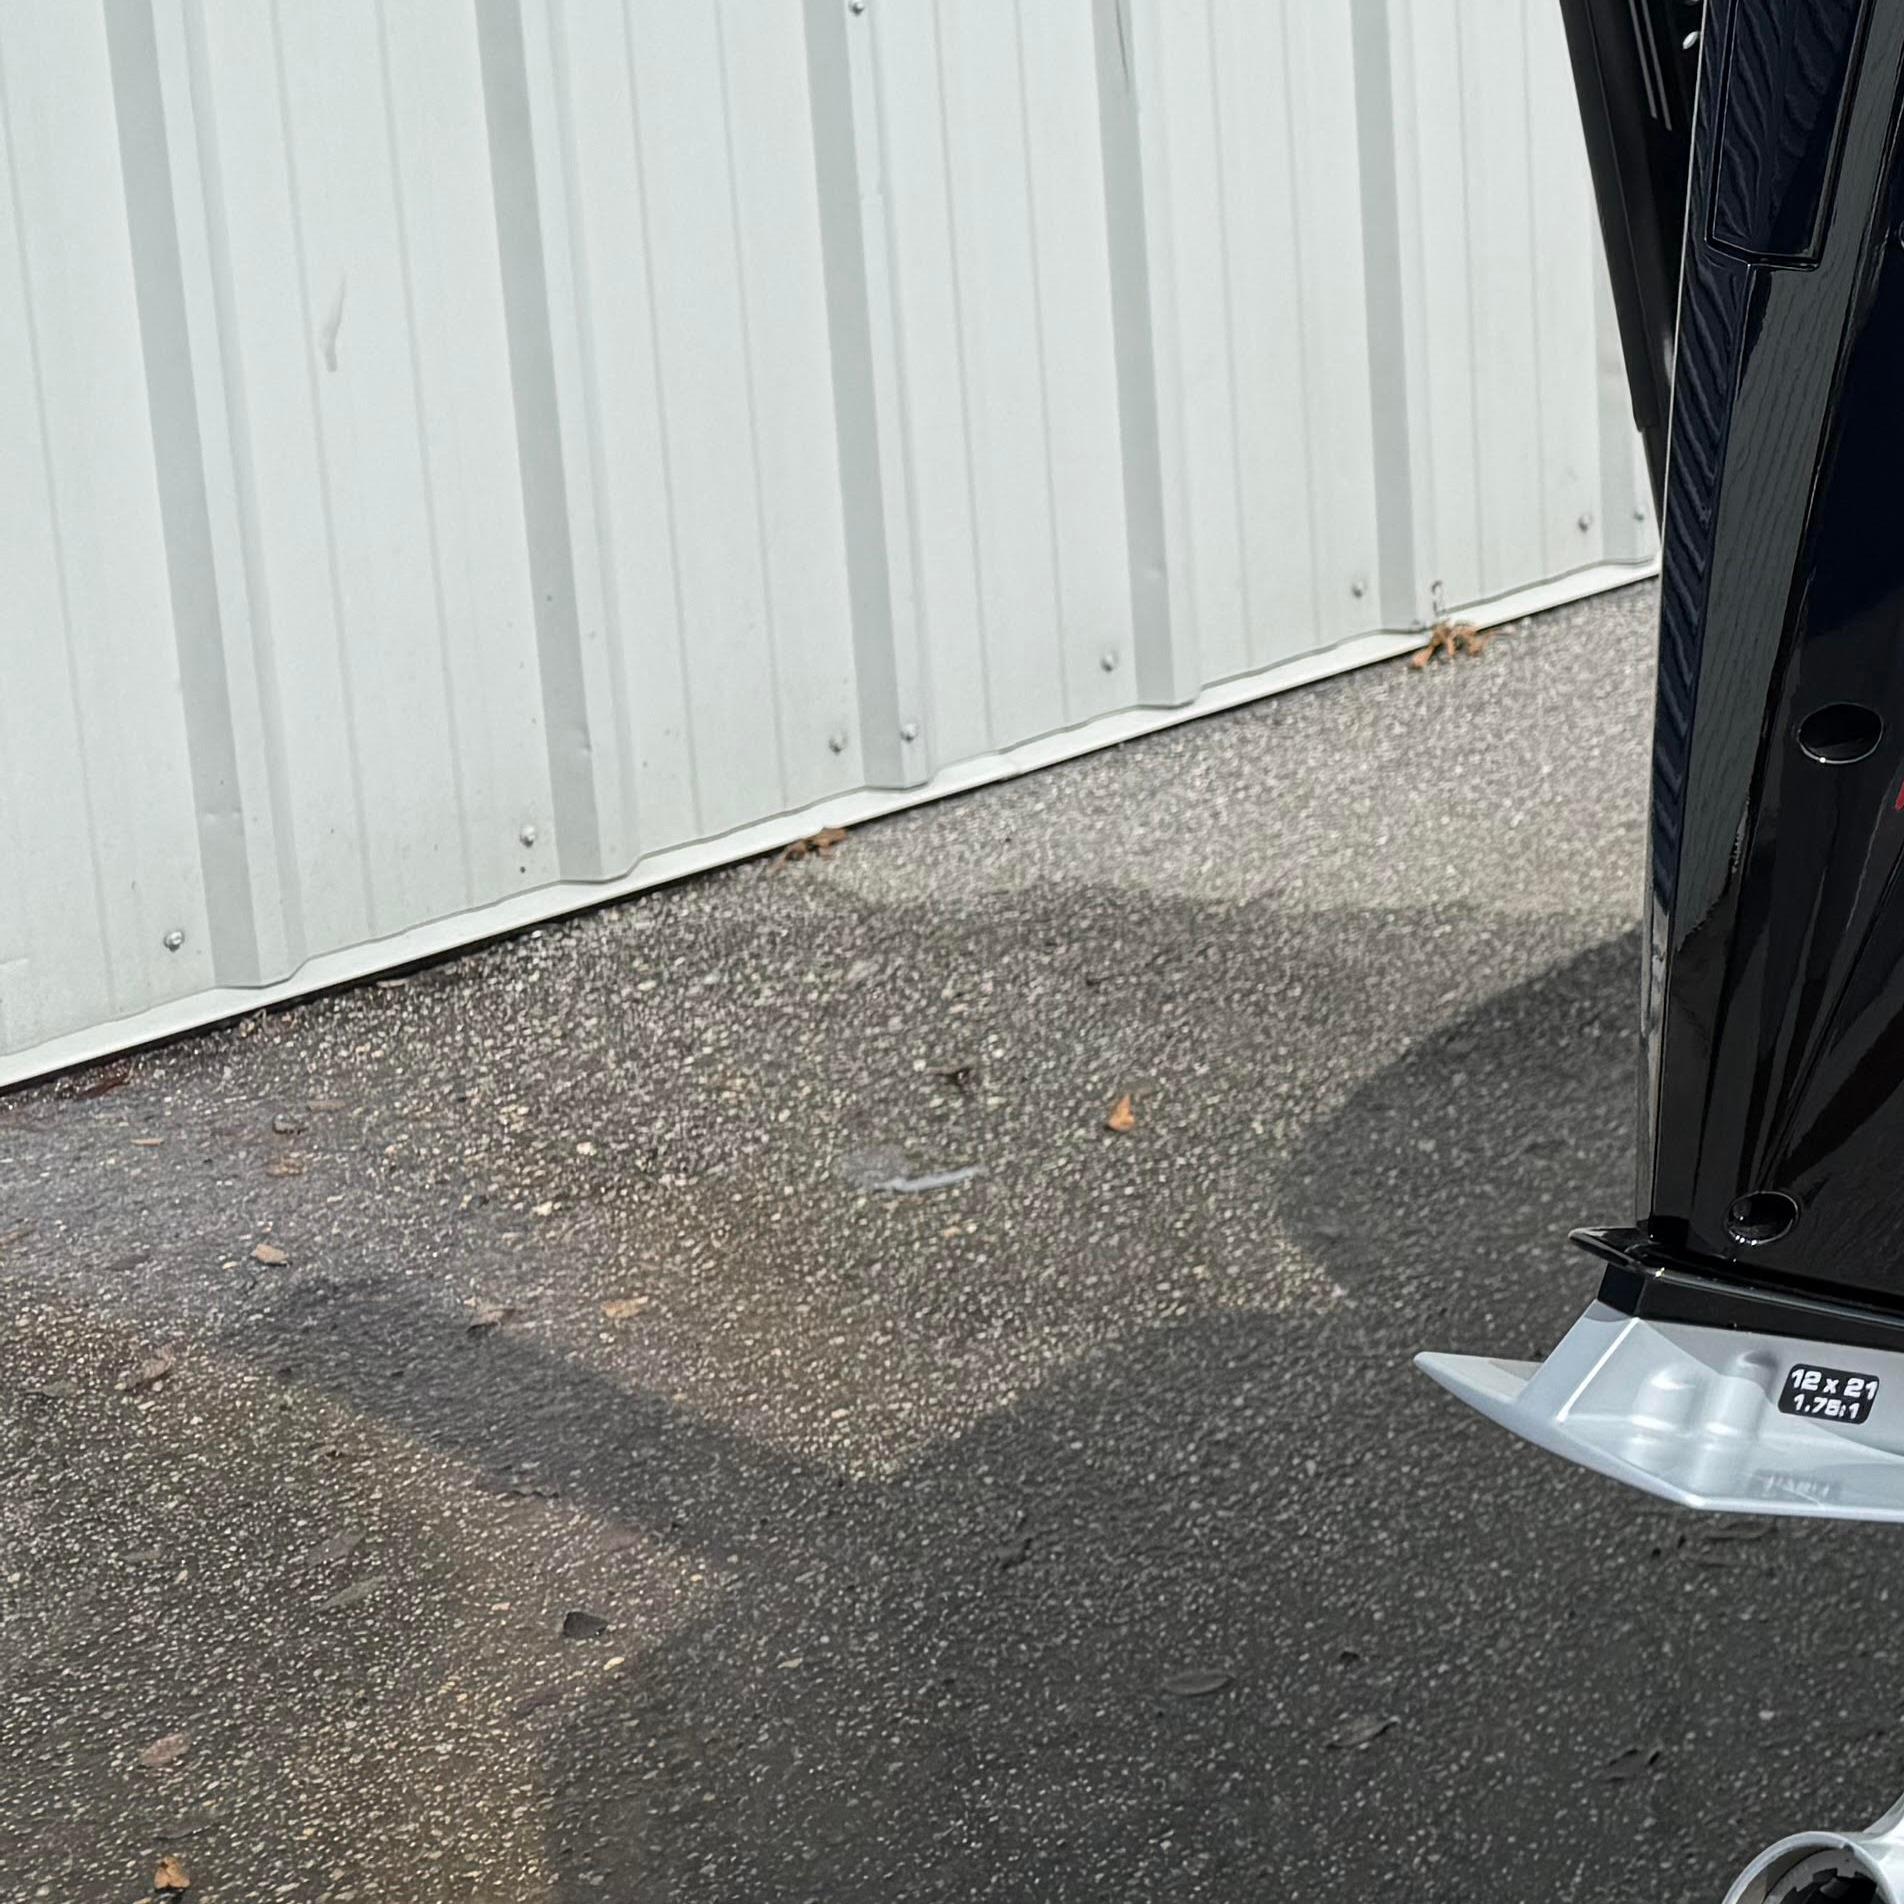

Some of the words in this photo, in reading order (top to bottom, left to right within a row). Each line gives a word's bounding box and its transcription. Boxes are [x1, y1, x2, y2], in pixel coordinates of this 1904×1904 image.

[1791, 1368, 1822, 1392] 12
[1823, 1378, 1840, 1395] x
[1843, 1377, 1878, 1401] 21
